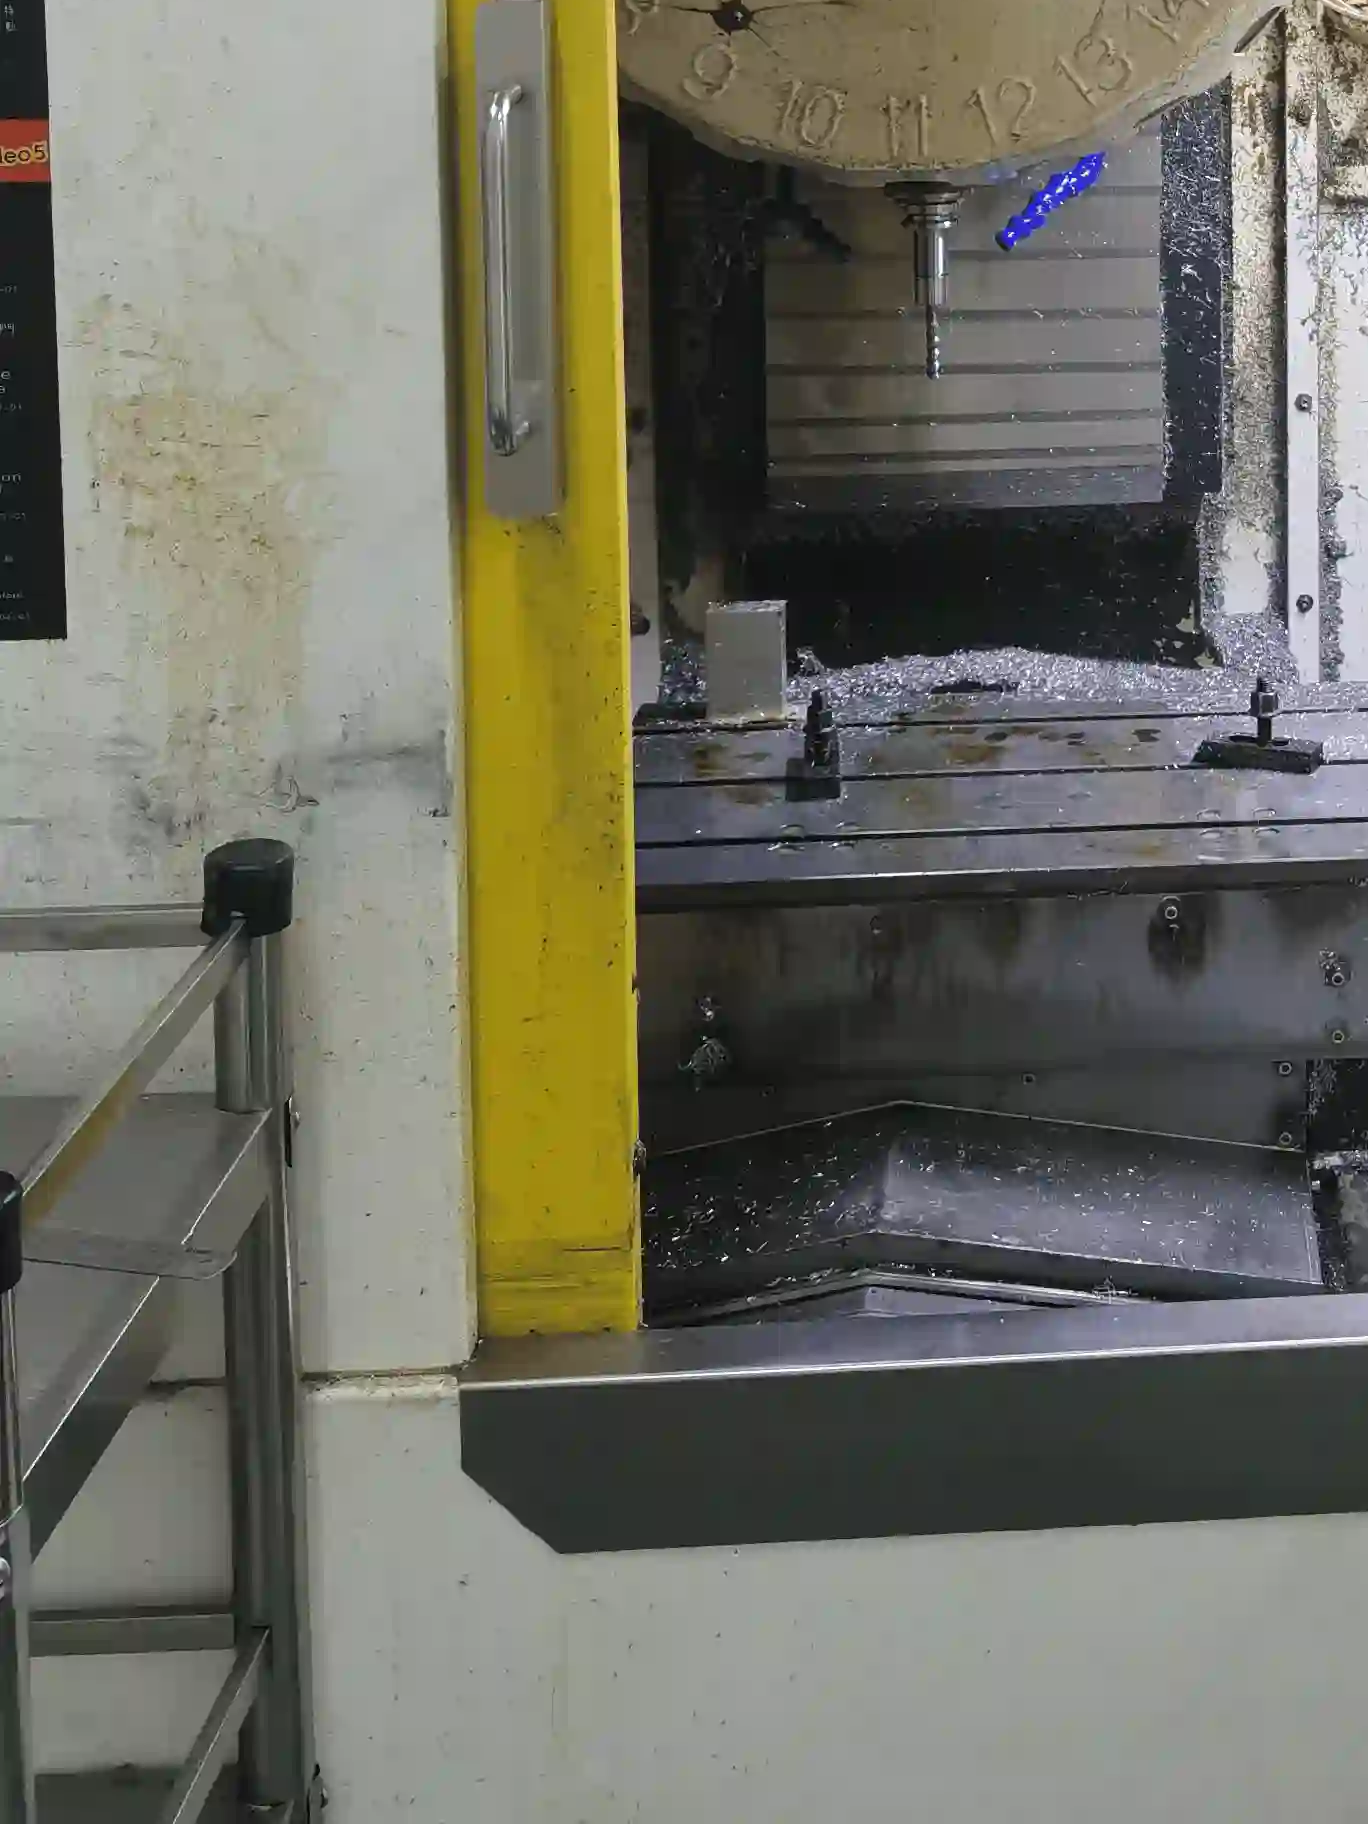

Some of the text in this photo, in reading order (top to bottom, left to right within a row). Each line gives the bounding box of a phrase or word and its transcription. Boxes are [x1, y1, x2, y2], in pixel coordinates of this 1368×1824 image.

[1055, 34, 1132, 107] 13
[779, 81, 847, 149] 10
[880, 92, 931, 158] 11
[967, 78, 1037, 145] 12
